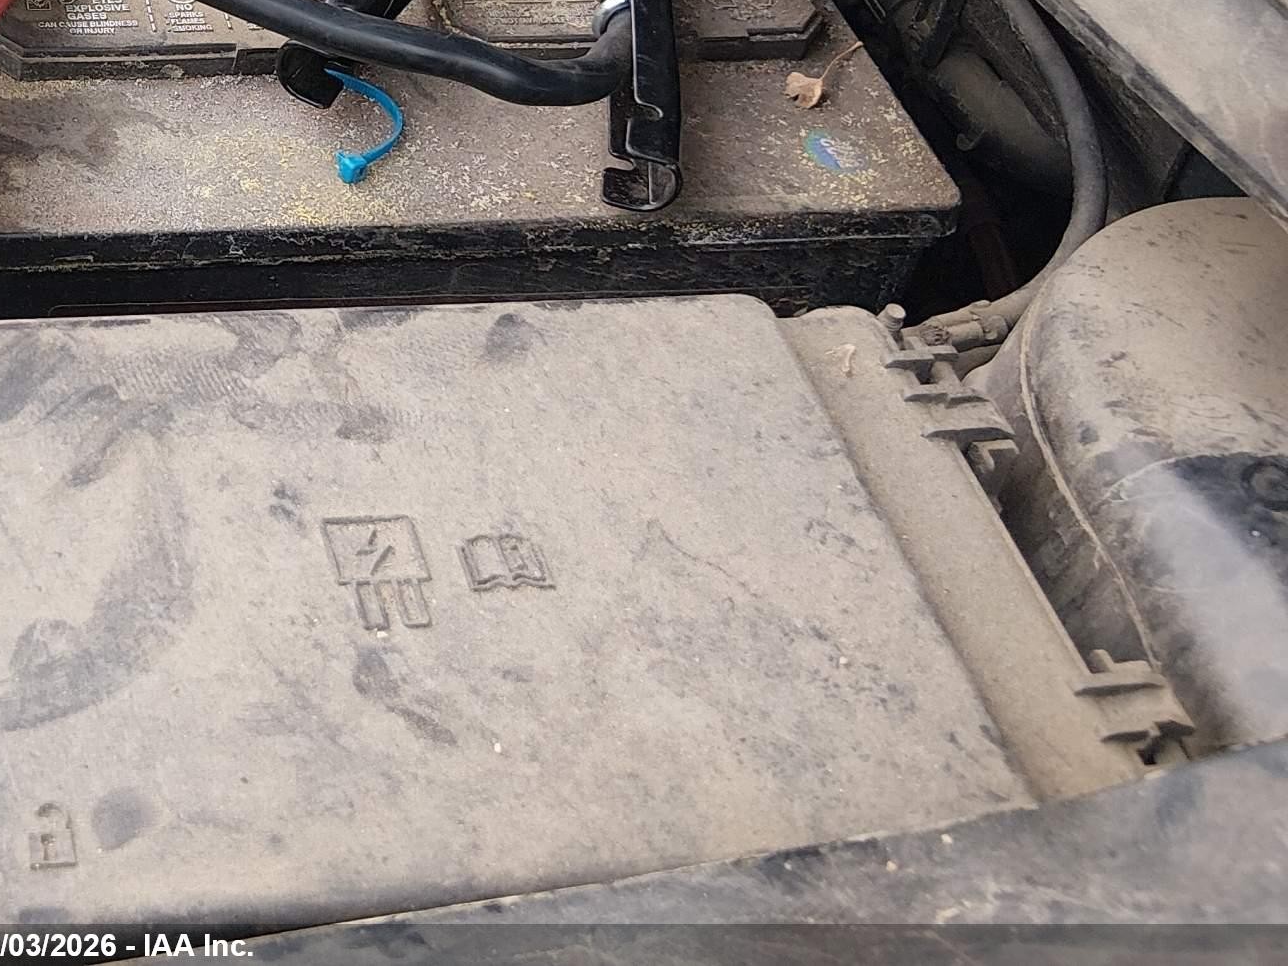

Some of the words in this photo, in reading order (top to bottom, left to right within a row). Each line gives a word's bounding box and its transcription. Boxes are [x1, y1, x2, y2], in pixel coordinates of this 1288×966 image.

[66, 3, 130, 13] EXPLOSIVE
[175, 3, 193, 11] NO
[67, 12, 107, 21] GASES
[38, 20, 57, 29] CAN
[59, 20, 88, 29] CAUSE
[89, 18, 138, 28] BLINDNESS
[70, 27, 82, 35] OR
[83, 26, 115, 35] INJURY
